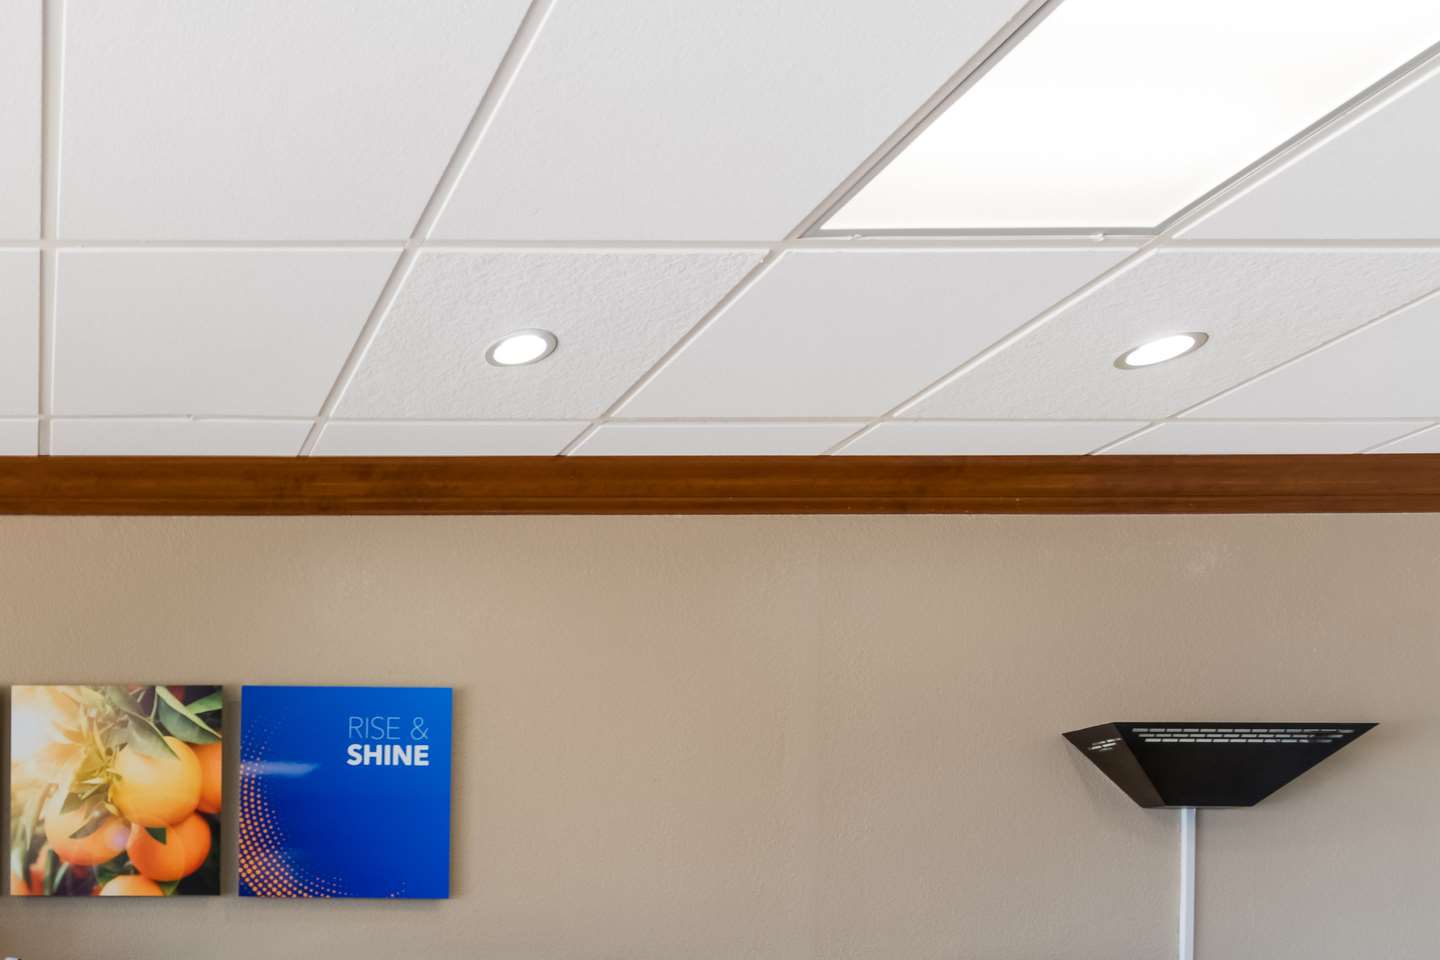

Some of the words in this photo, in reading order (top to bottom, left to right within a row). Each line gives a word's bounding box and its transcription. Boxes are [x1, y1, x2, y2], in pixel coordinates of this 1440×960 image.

[348, 715, 401, 740] RISE
[410, 716, 429, 740] &
[346, 743, 430, 767] SHINE
